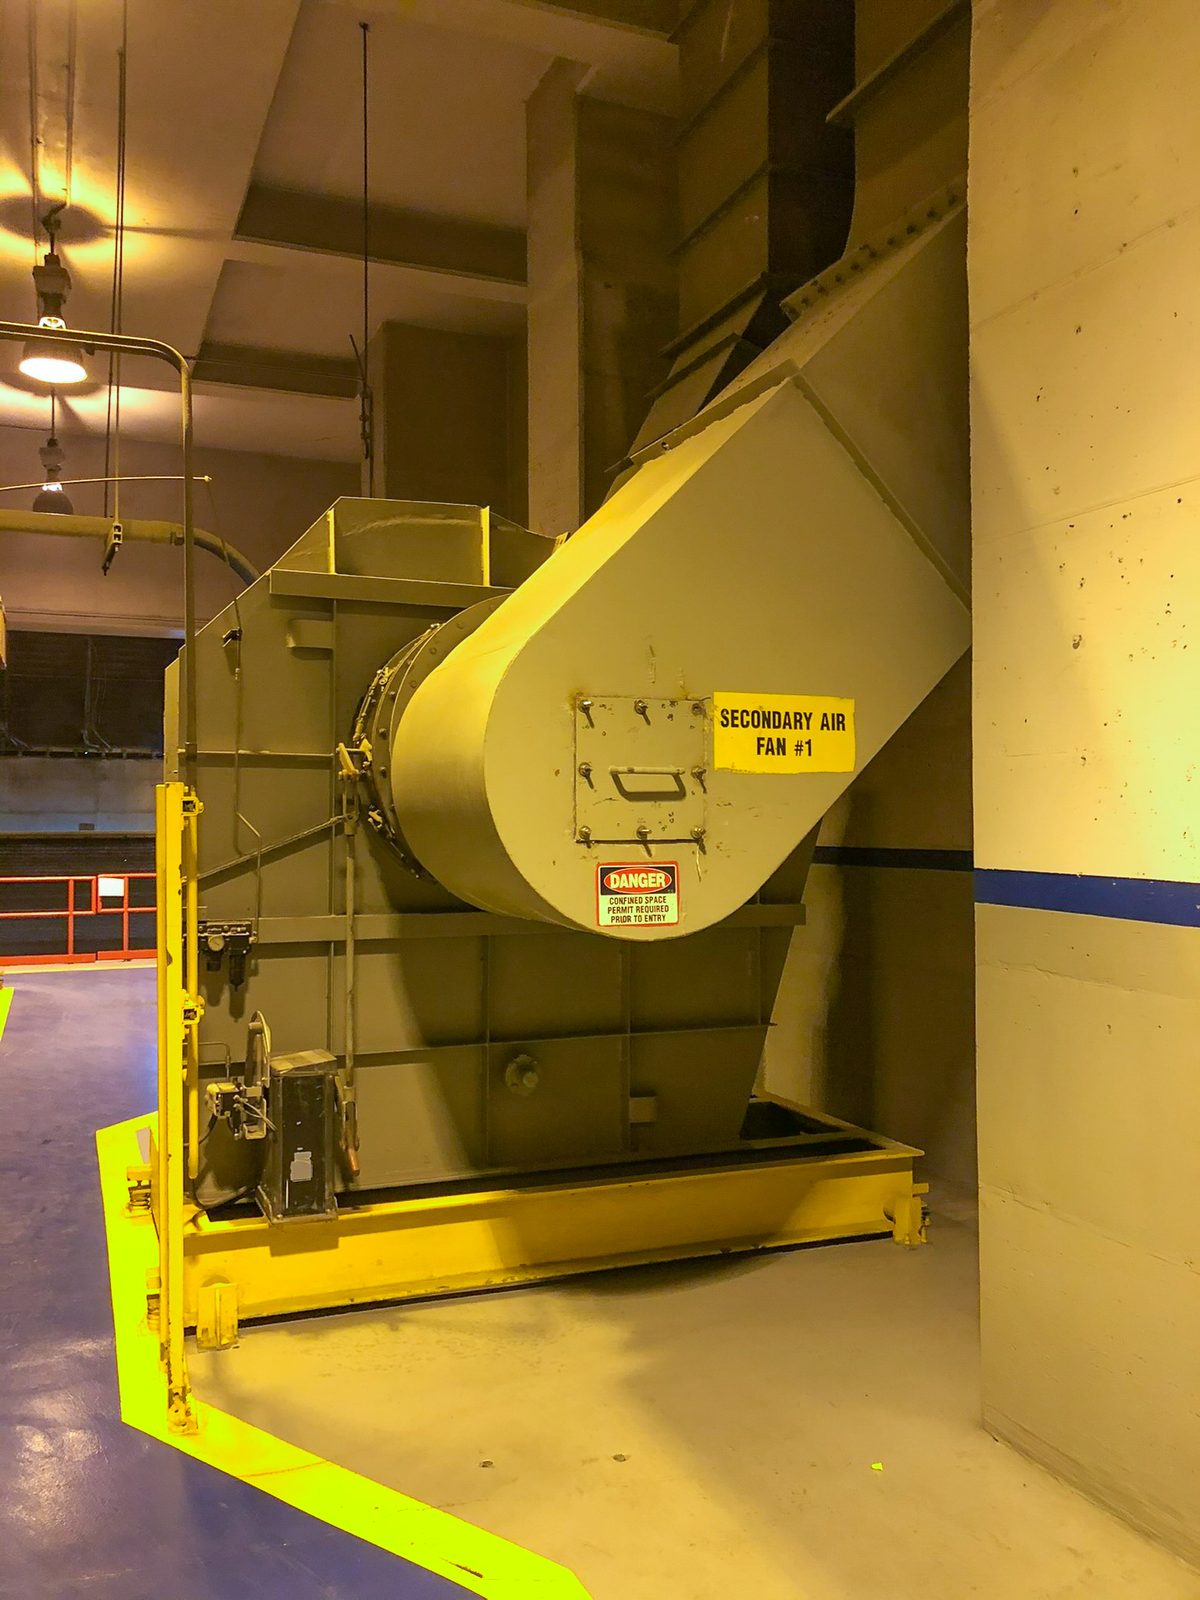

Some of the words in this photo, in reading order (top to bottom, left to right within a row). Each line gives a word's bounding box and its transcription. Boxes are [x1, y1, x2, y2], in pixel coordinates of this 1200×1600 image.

[720, 708, 813, 731] SECONDARY
[820, 712, 846, 731] AIR
[756, 737, 787, 757] FAN
[794, 739, 812, 757] #1
[610, 873, 666, 889] DANGER
[609, 896, 643, 905] CONFINED
[645, 896, 667, 904] SPACE
[608, 906, 633, 914] PERMIT
[636, 905, 669, 914] REQUIRED
[611, 915, 632, 923] PRIOR
[645, 914, 666, 922] ENTRY
